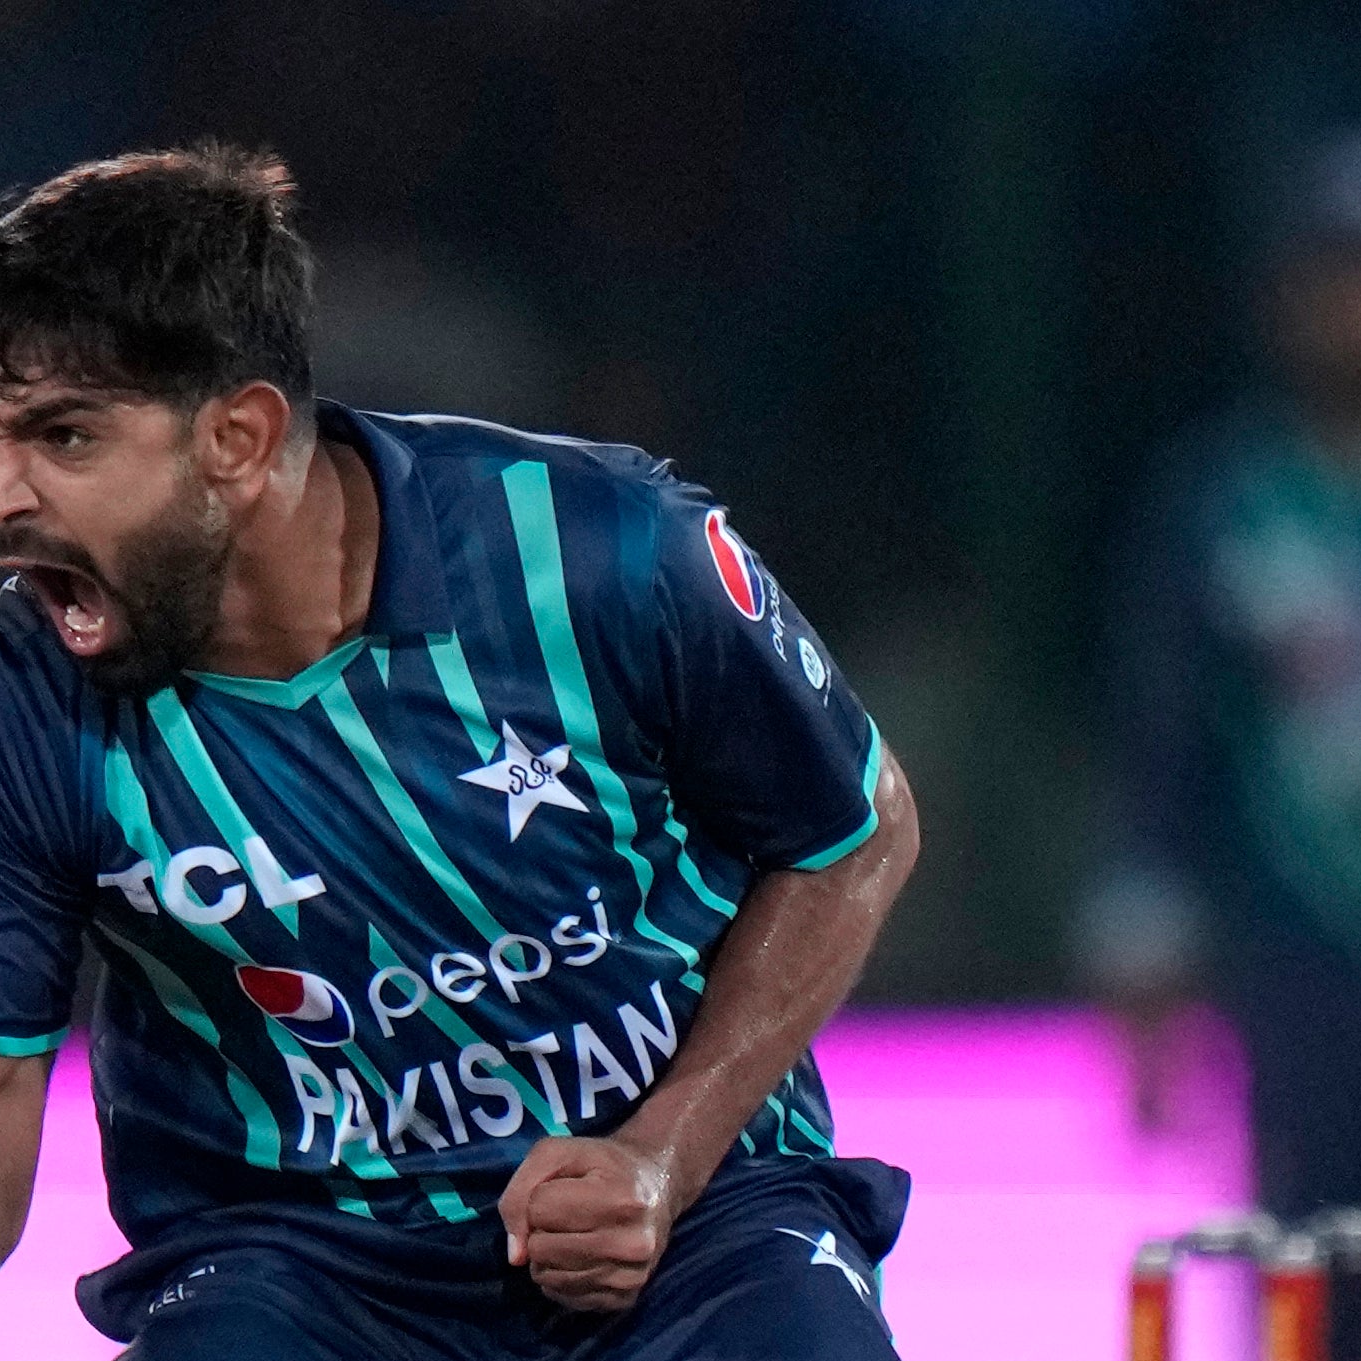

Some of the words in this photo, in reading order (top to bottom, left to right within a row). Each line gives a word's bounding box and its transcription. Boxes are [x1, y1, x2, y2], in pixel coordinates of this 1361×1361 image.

[97, 835, 327, 926] TCL
[368, 885, 621, 1038] pepsi
[286, 980, 678, 1166] PAKISTAN
